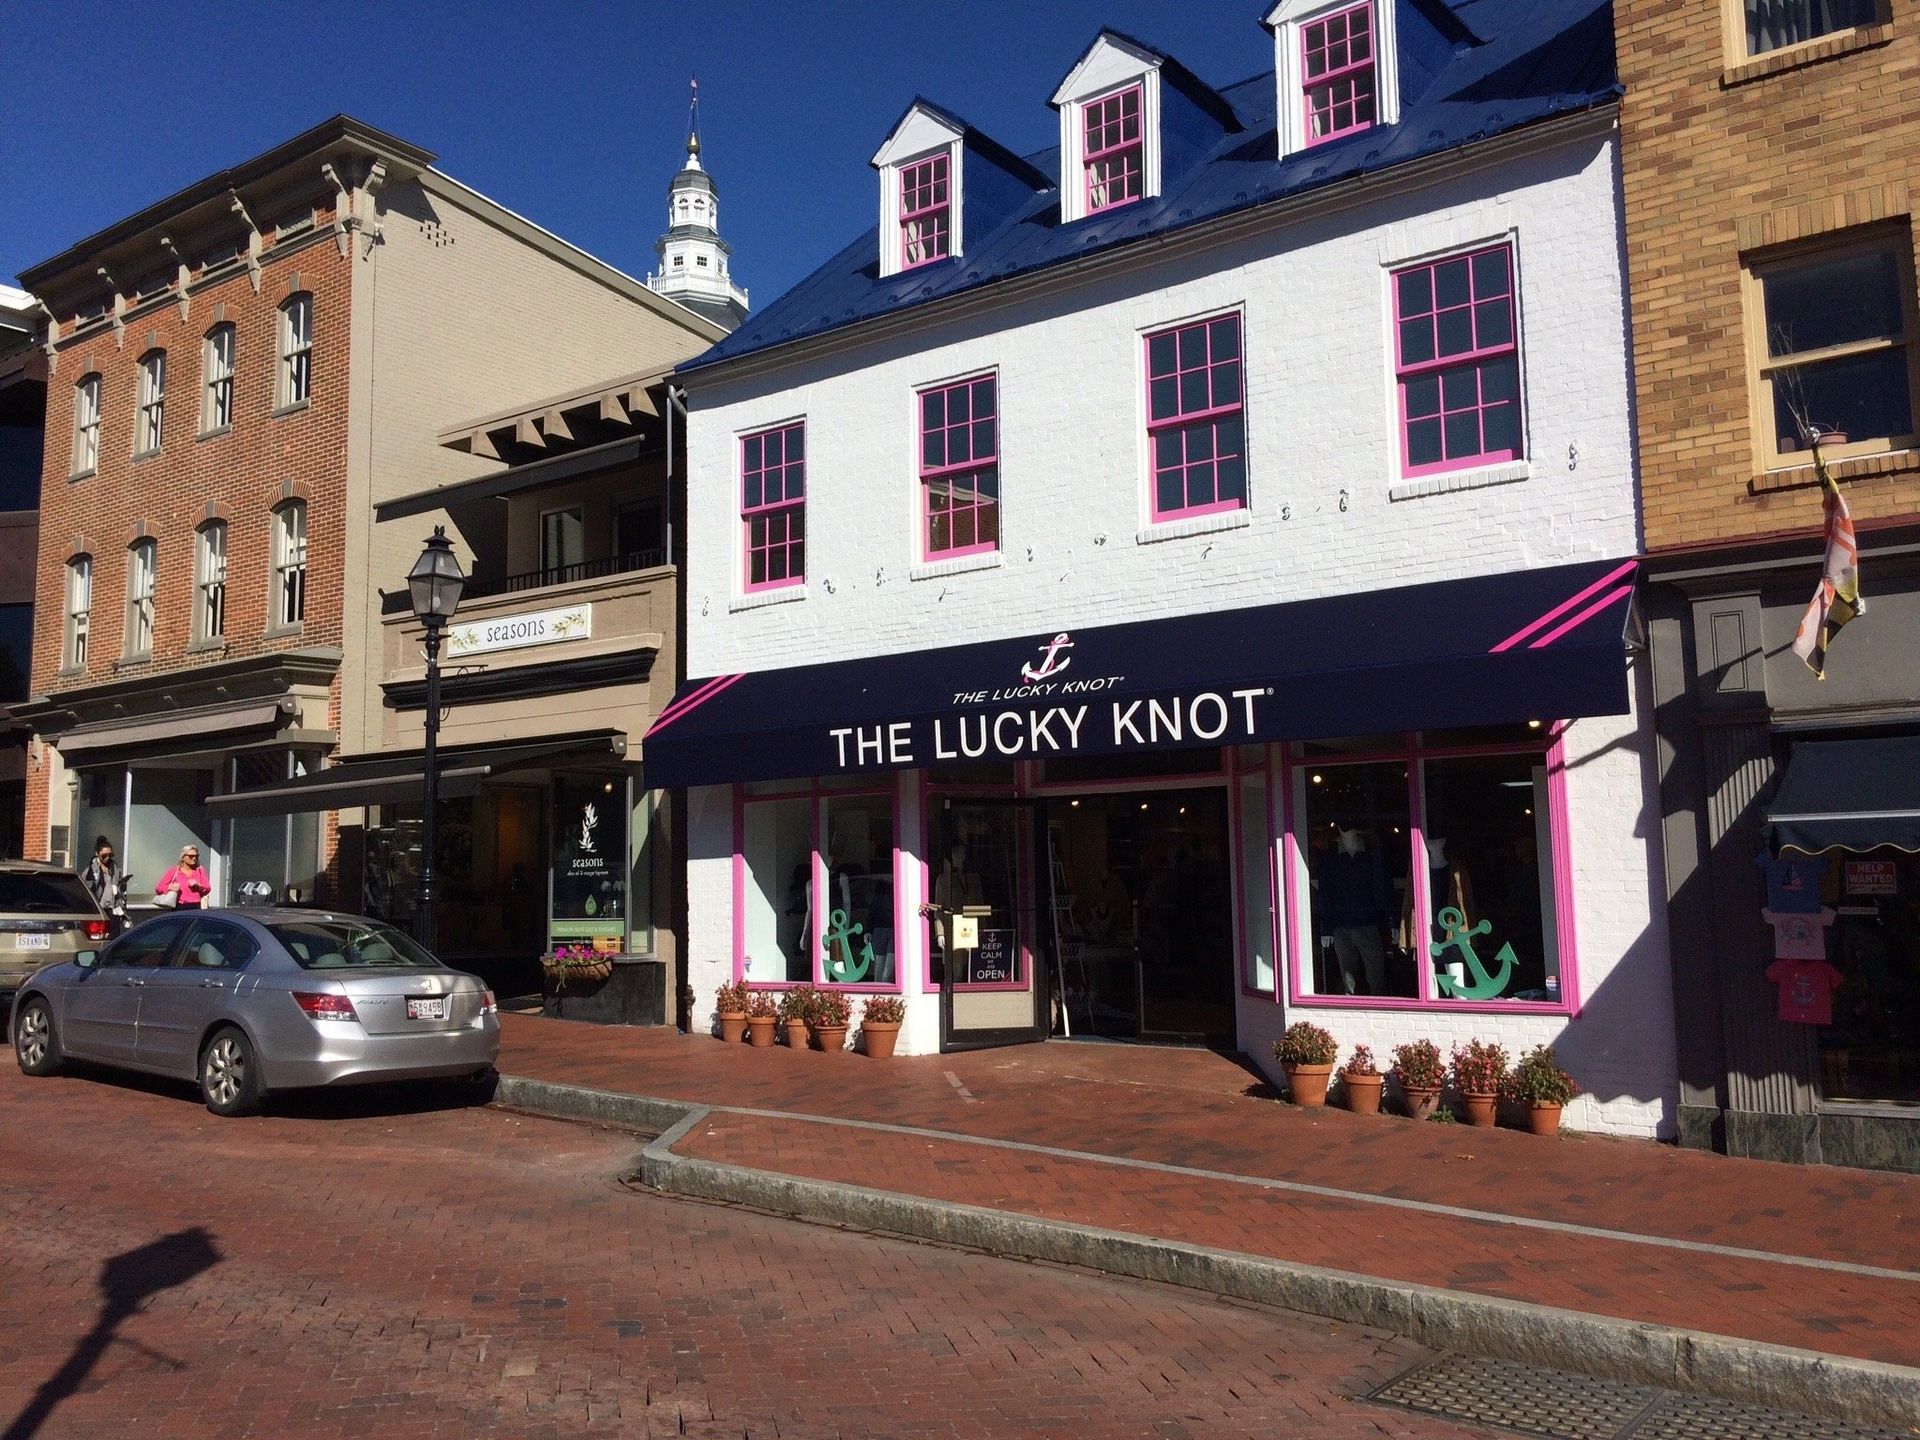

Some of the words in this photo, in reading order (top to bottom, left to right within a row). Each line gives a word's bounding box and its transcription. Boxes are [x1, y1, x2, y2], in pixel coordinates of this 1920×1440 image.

[487, 619, 545, 642] seasons
[952, 690, 989, 705] THE
[991, 682, 1058, 701] LUCKY
[829, 721, 914, 767] THE
[934, 705, 1088, 759] LUCKY
[572, 857, 604, 868] seasons
[1857, 864, 1884, 873] HELP
[1849, 873, 1894, 884] WANTED
[980, 951, 1002, 959] CALM
[976, 969, 1005, 979] OPEN
